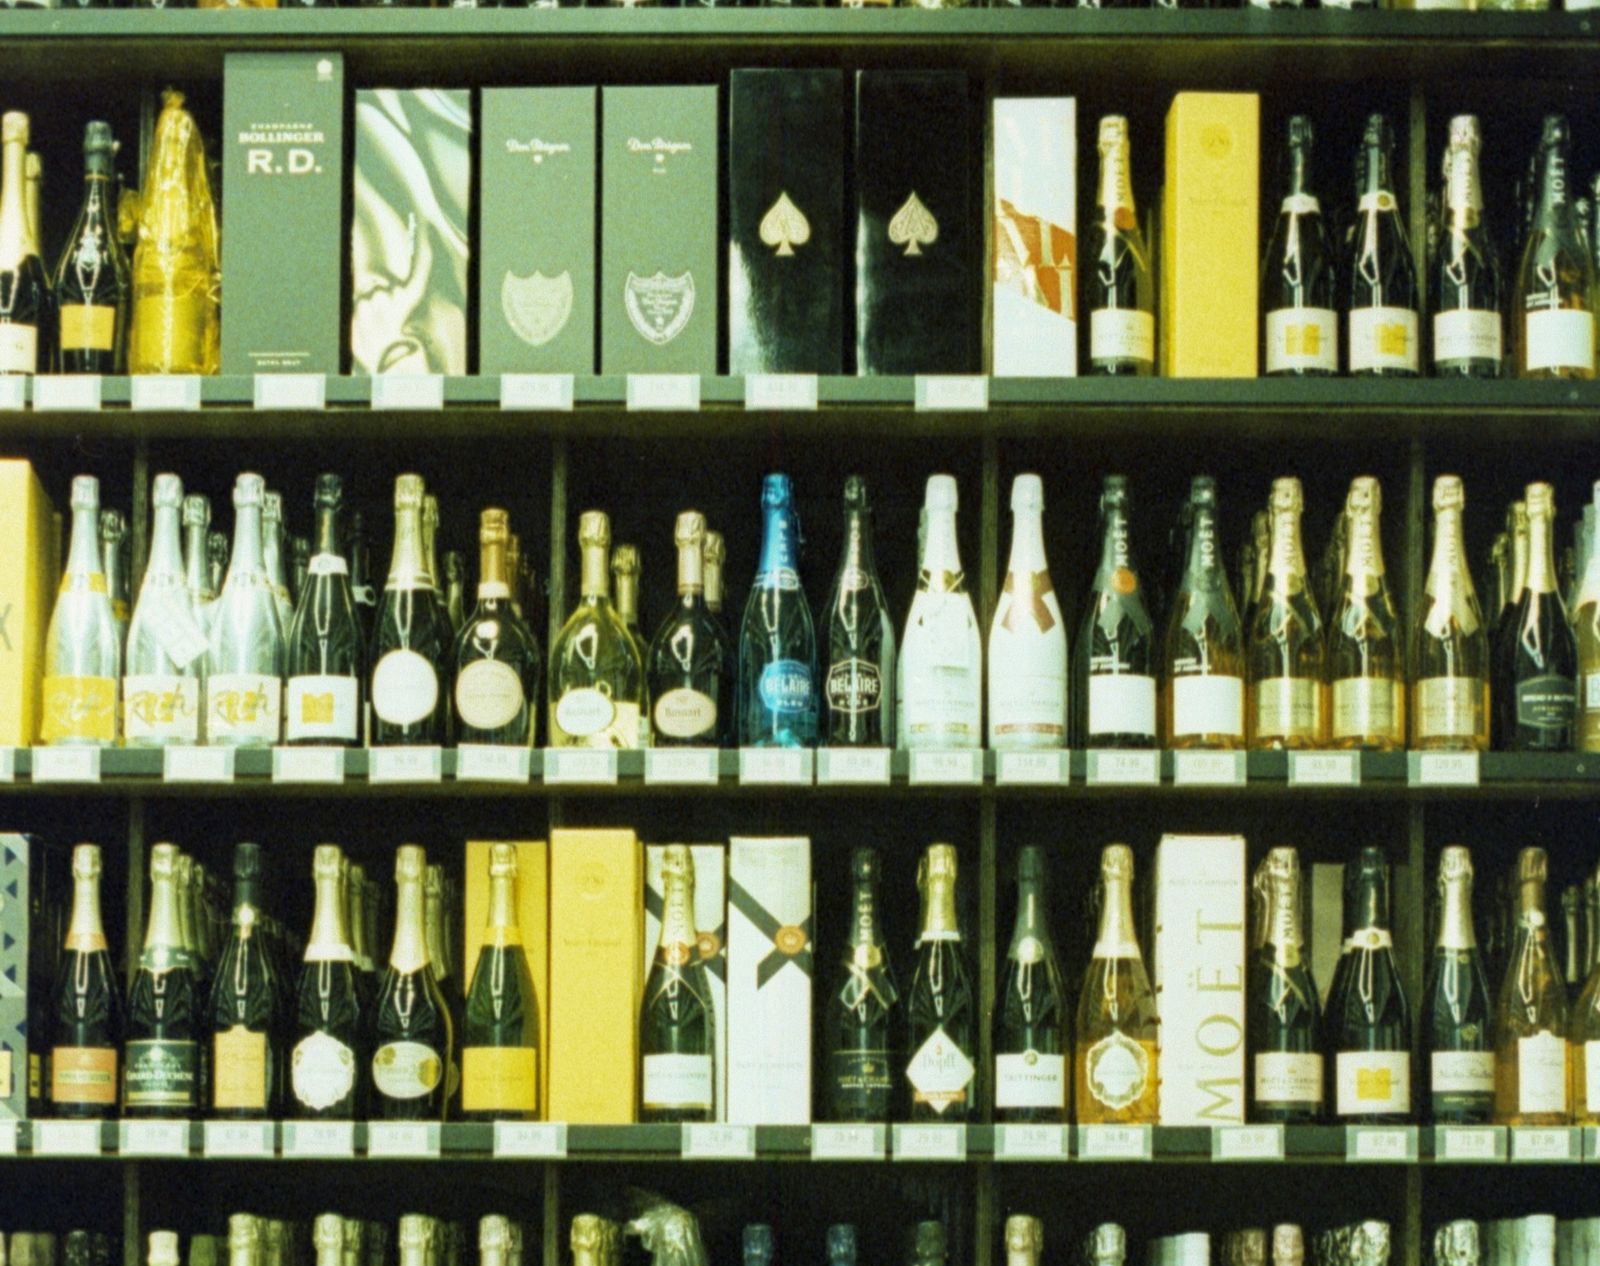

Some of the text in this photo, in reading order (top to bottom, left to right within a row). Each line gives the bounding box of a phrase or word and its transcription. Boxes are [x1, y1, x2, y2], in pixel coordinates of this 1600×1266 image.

[238, 131, 325, 144] BOLLINGER
[247, 147, 324, 174] R.D.
[766, 676, 811, 697] BELAIRE
[829, 676, 880, 697] BELAIRE
